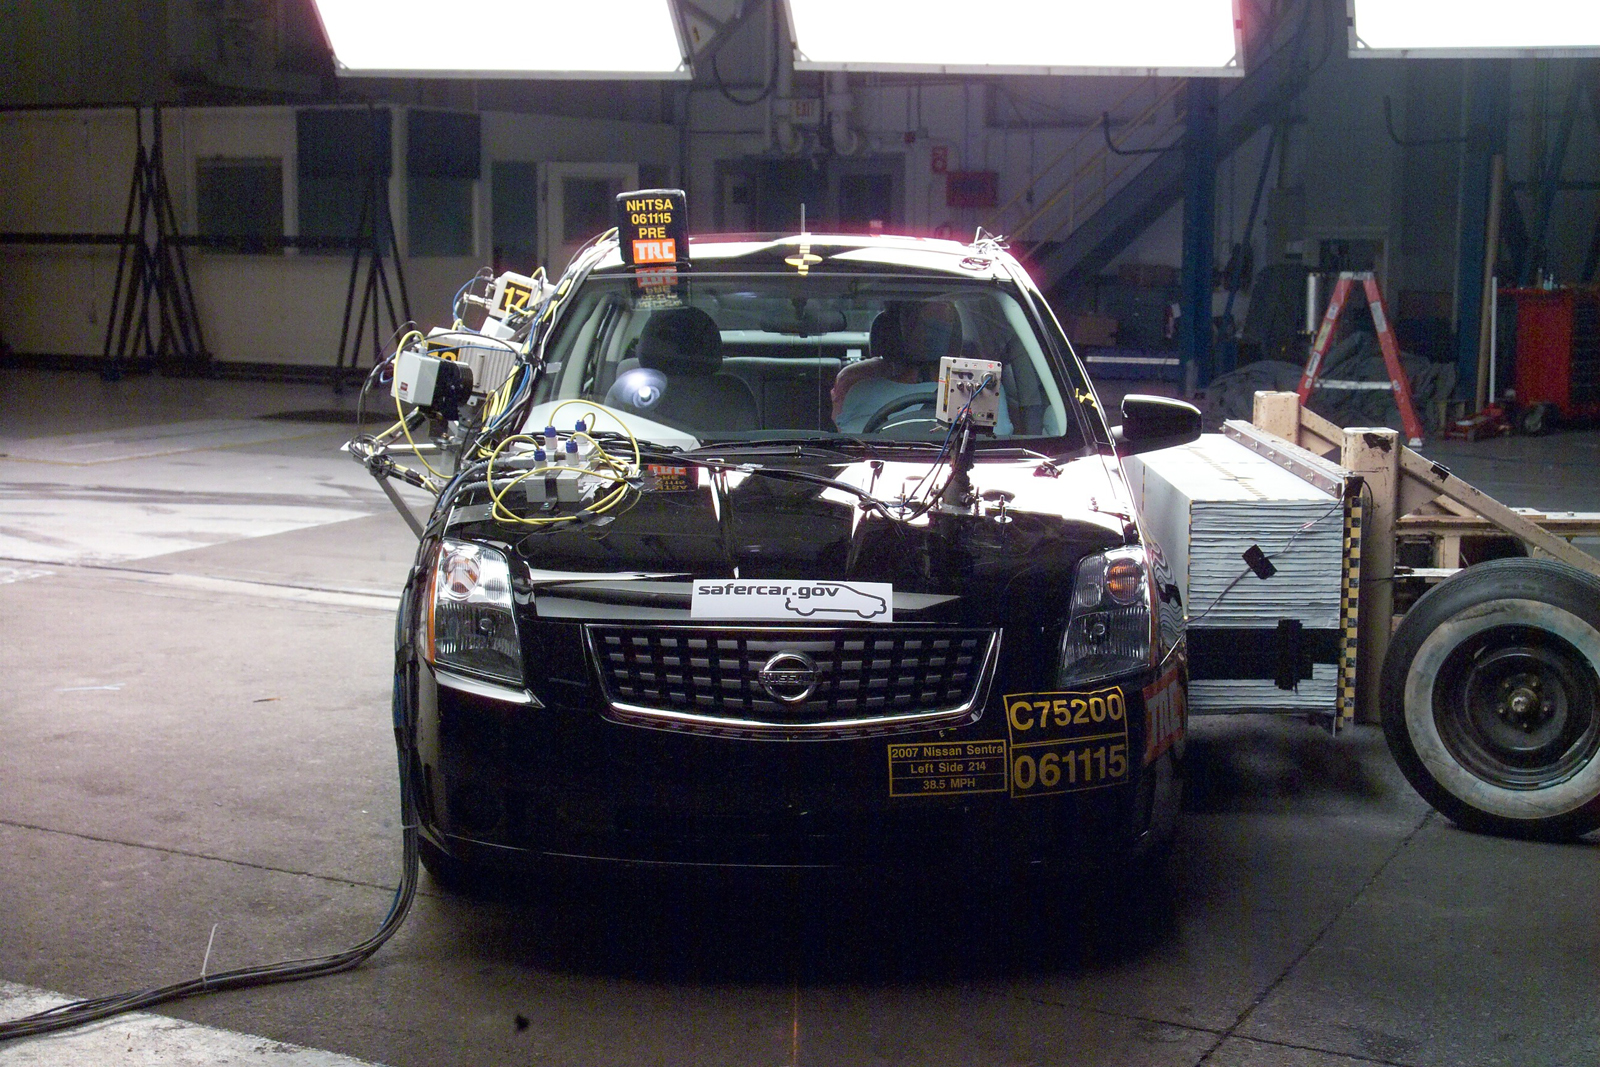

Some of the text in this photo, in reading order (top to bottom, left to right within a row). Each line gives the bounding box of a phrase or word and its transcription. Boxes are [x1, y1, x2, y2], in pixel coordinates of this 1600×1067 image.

[626, 199, 673, 212] NHTSA
[631, 213, 672, 225] 061115
[639, 227, 666, 239] PRE
[635, 242, 674, 260] TRC
[503, 286, 531, 312] 17
[698, 583, 840, 599] safercar.gov
[1009, 694, 1123, 731] C75200
[892, 744, 1004, 758] 2007 Nissan Sentra
[910, 761, 987, 774] Left Side 214
[1013, 745, 1127, 790] 061115
[922, 777, 976, 790] 38.5 MPH
